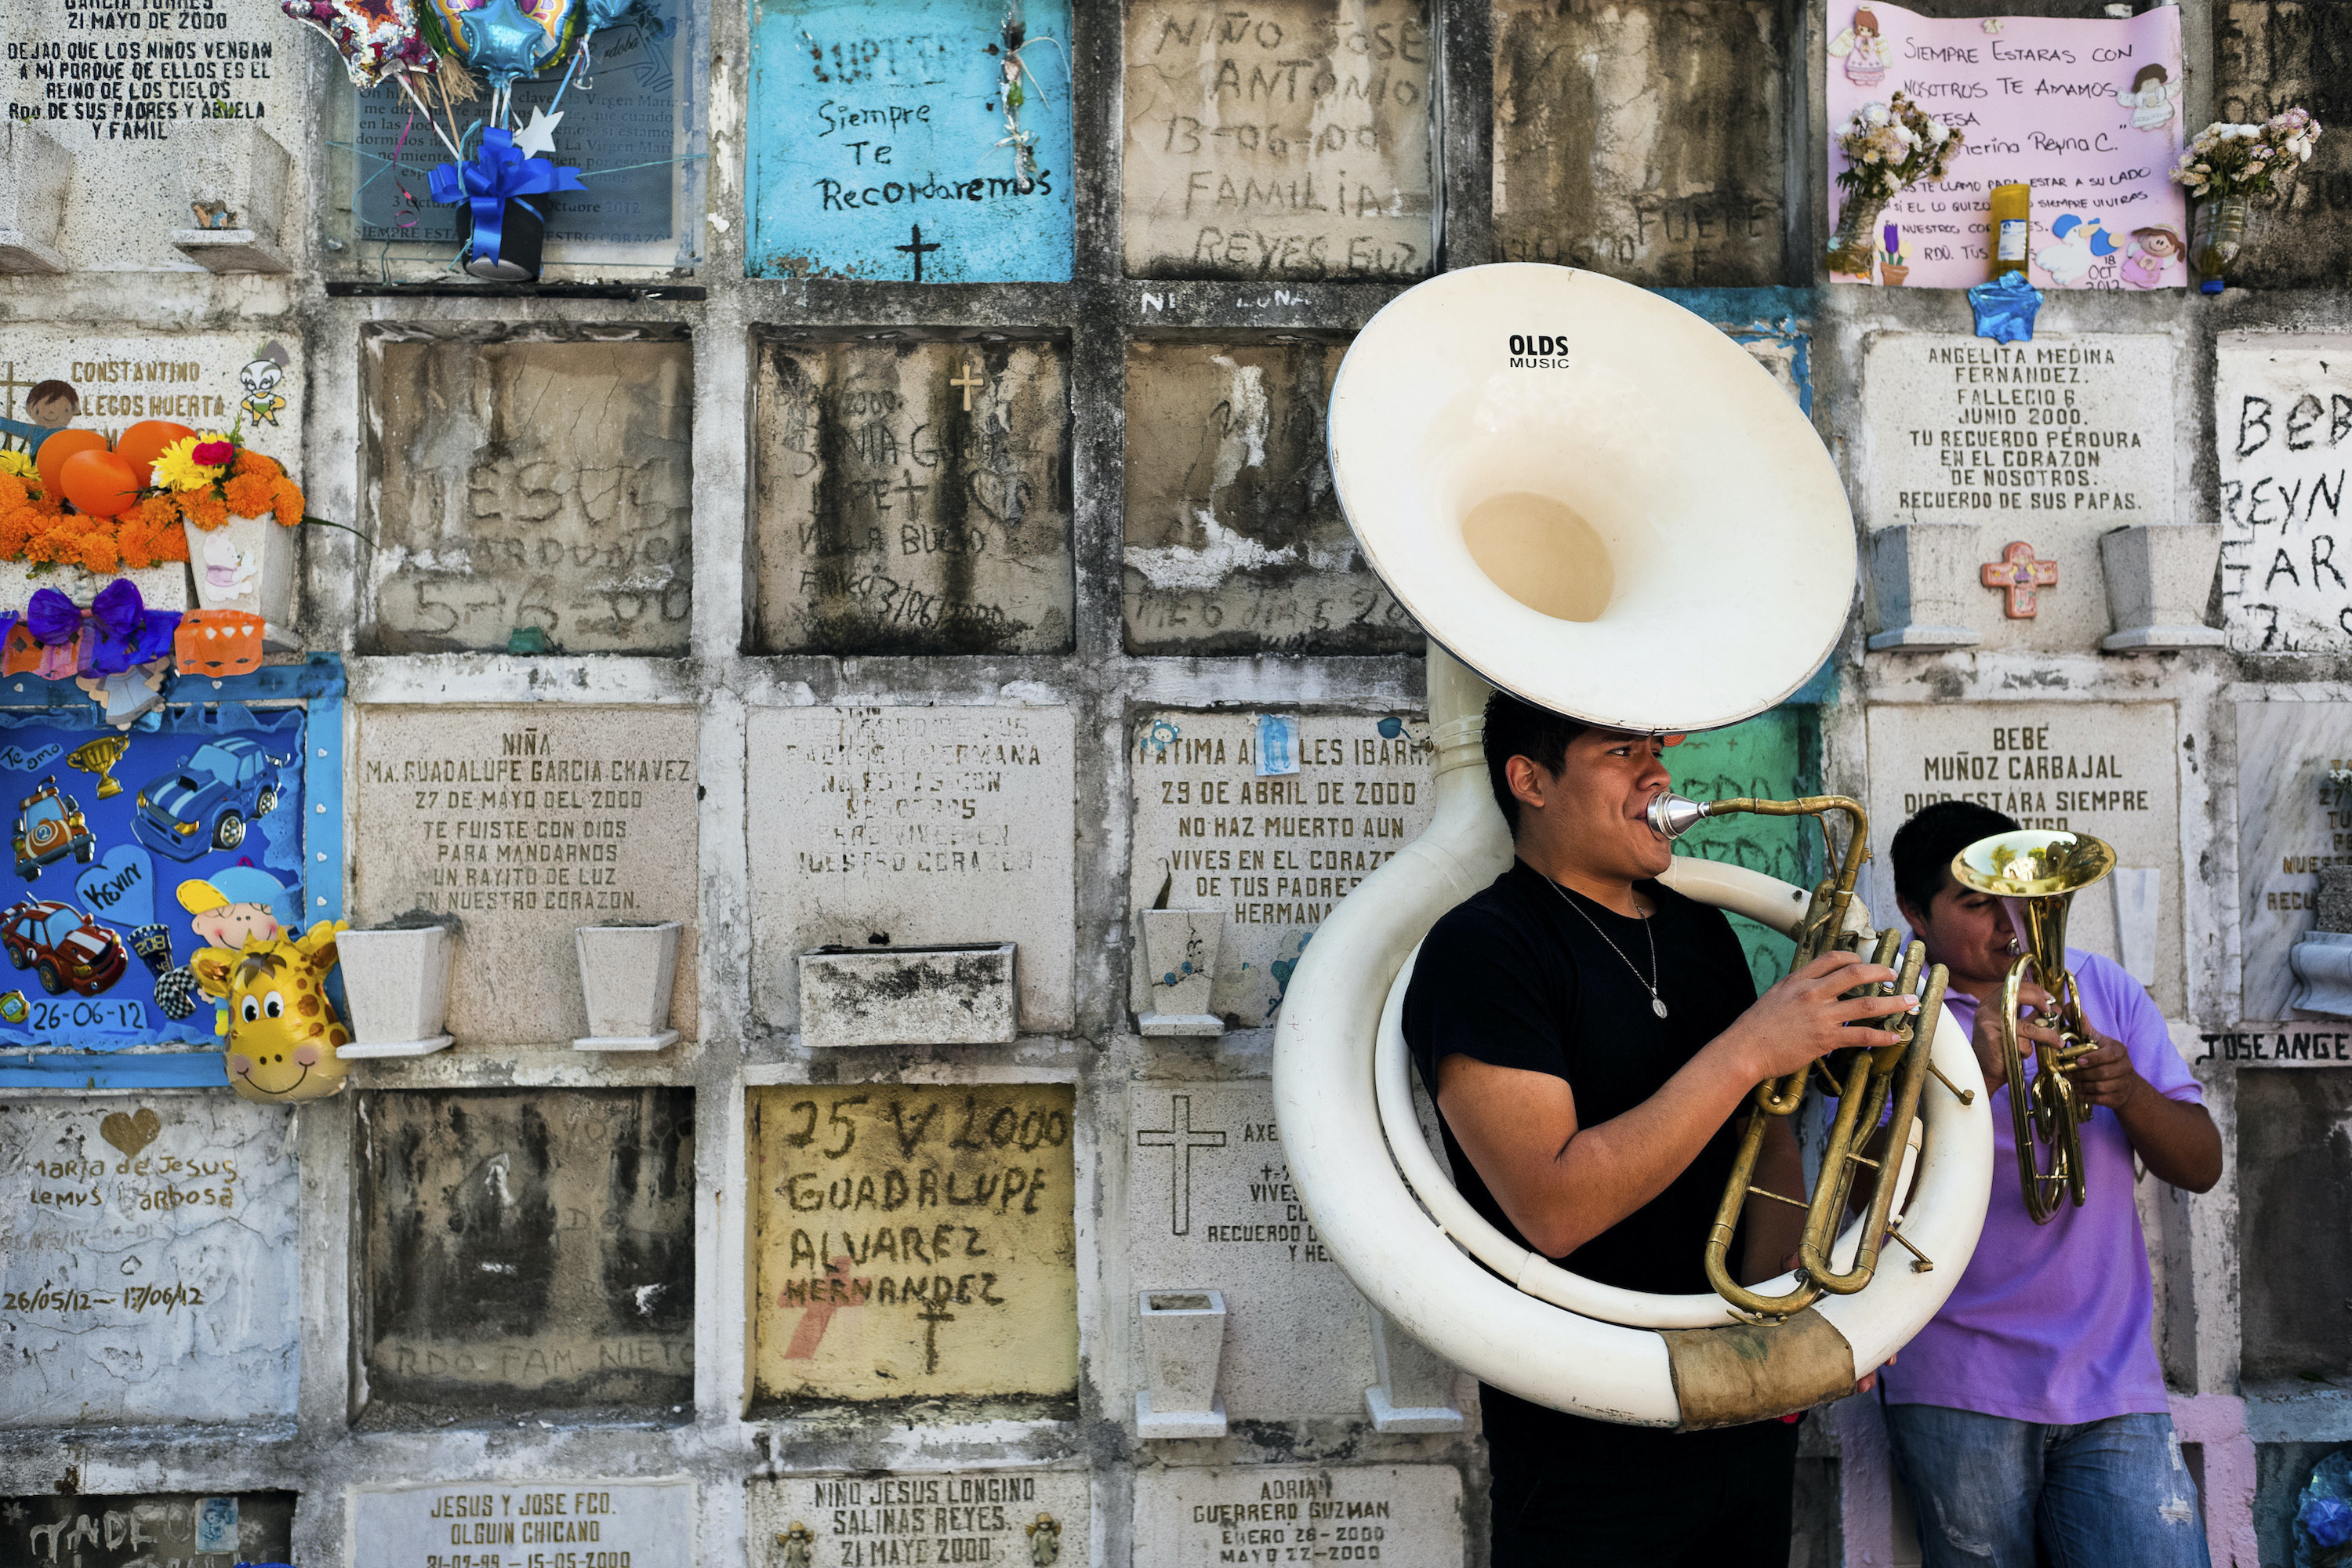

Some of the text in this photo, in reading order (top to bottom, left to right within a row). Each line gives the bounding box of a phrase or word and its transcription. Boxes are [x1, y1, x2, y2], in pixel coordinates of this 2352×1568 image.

[68, 11, 227, 29] 21 MAYO DE 2000
[68, 42, 98, 60] QUE
[105, 42, 140, 59] LOS
[205, 42, 272, 59] VENGAN
[1904, 38, 2132, 63] SIEMPRE ESTARAS CON
[20, 64, 27, 79] A
[60, 62, 125, 80] PORQUE
[132, 62, 153, 81] DE
[162, 62, 216, 78] ELLOS
[224, 62, 244, 78] ES
[251, 62, 270, 78] EL
[1209, 58, 1418, 106] ANTONIO
[46, 81, 230, 100] REINO DE LOS CIELOS
[1904, 78, 2118, 98] NOSOTROS TE AMAMOS
[818, 100, 930, 136] Siempre
[845, 141, 893, 165] Te
[2028, 131, 2089, 155] Reyna
[813, 169, 1052, 211] Recordaremos
[1919, 183, 1934, 192] TE
[1940, 182, 1981, 192] LLAMO
[2031, 178, 2067, 187] ESTAR
[2110, 167, 2151, 185] LADO
[1185, 169, 1383, 220] FAMILIA
[1907, 203, 1925, 212] EL
[1932, 202, 1946, 212] LO
[2093, 191, 2148, 207] VIVIRAS
[1902, 225, 1959, 234] NUESTROS
[1961, 245, 1988, 260] TUS
[2104, 256, 2116, 264] 18
[2089, 266, 2117, 280] OCT
[1509, 335, 1568, 357] OLDS
[1929, 348, 2115, 365] ANGELITA MEDINA
[71, 361, 201, 383] CONSTANTINO
[1510, 358, 1569, 368] MUSIC
[1956, 368, 2089, 384] FERNANDEZ.
[149, 394, 225, 417] HUERTA
[1958, 390, 2076, 405] FALLECIO 6
[1958, 408, 2089, 425] JUNIO 2000.
[1910, 430, 2141, 448] TU RECUERDO PERDURA
[1940, 451, 2100, 467] EN EL CORAZON
[1951, 470, 2098, 486] DE NOSOTROS.
[1900, 492, 2142, 510] RECUERDO DE SUS PAPAS.
[503, 728, 550, 756] NIÑA
[2, 749, 24, 767] Te
[1924, 751, 2122, 781] MUÑOZ CARBAJAL
[405, 760, 523, 782] GUADALUPE
[531, 761, 602, 782] GARCIA
[612, 760, 691, 782] CHAVEZ
[416, 791, 643, 809] 27 DE MAYO DEL 2000
[1162, 782, 1417, 805] 29 DE ABRIL DE 2000
[2056, 790, 2148, 811] SIEMPRE
[424, 821, 626, 840] TE FUISTE CON DIOS
[1179, 817, 1403, 838] NO HAZ MUERTO AUN
[437, 844, 618, 862] PARA MANDARNOS
[1172, 851, 1300, 870] VIVES EN EL
[434, 868, 616, 886] UN RAYITO DE LUZ
[1197, 877, 1269, 897] DE TUS
[416, 891, 641, 909] EN NUESTRO CORAZON.
[34, 1002, 143, 1030] 26-06-12
[2197, 1033, 2270, 1064] JOSE
[787, 1098, 866, 1160] 25
[117, 1160, 149, 1175] de
[787, 1167, 1045, 1215] GUADALUPE
[1208, 1225, 1301, 1242] RECUERDO
[790, 1225, 986, 1272] ALVAREZ
[870, 1480, 938, 1505] JESUS
[947, 1478, 1035, 1504] LONGINO
[431, 1493, 616, 1518] JESUS Y JOSE FCO.
[1194, 1501, 1389, 1523] GUERRERO GUZMAN
[833, 1506, 1011, 1535] SALINAS REYES.
[451, 1521, 599, 1544] OLGUIN CHICANO
[938, 1538, 990, 1563] 2000
